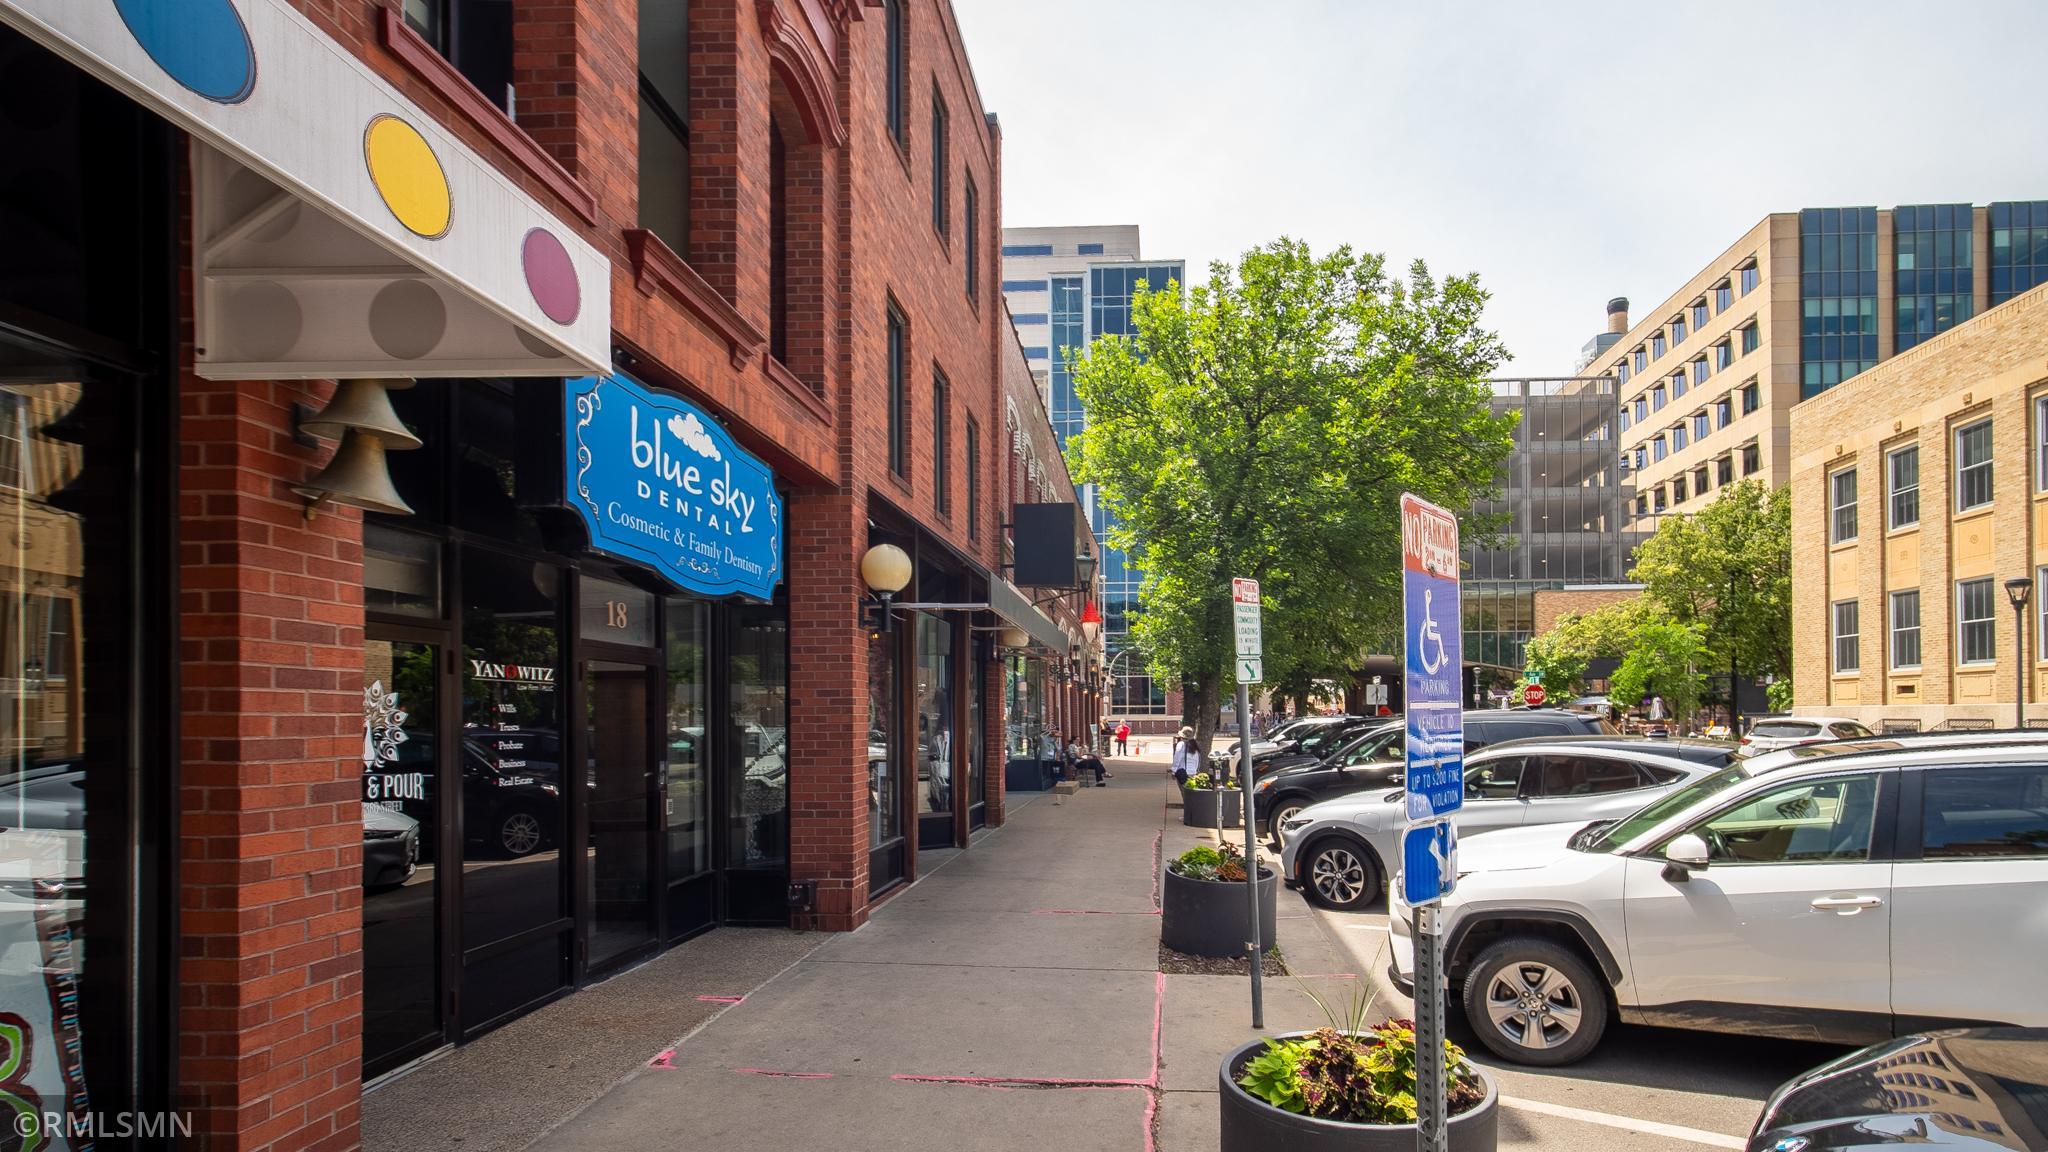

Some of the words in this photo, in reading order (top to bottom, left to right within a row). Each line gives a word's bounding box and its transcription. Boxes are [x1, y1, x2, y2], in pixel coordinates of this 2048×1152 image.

[630, 405, 702, 495] blue
[710, 460, 755, 532] sky
[637, 480, 732, 535] DENTAL
[608, 501, 670, 541] Cosmetic
[673, 527, 686, 548] &
[689, 533, 722, 566] Family
[724, 545, 763, 580] Dentistry
[1405, 510, 1420, 560] NO
[1423, 513, 1454, 552] PARKING
[606, 600, 627, 629] 18
[471, 659, 554, 681] YANOWITZ
[1420, 679, 1450, 697] PARKING
[1525, 690, 1543, 700] STOP
[1417, 713, 1444, 731] VEHICLE
[499, 759, 527, 769] Business
[367, 776, 381, 799] &
[383, 772, 424, 801] POUR
[498, 776, 514, 787] Real
[1411, 775, 1421, 792] UP
[1423, 773, 1431, 788] TO
[1448, 768, 1460, 783] FINE
[1413, 795, 1427, 813] FOR
[1433, 788, 1459, 808] VIOLATION
